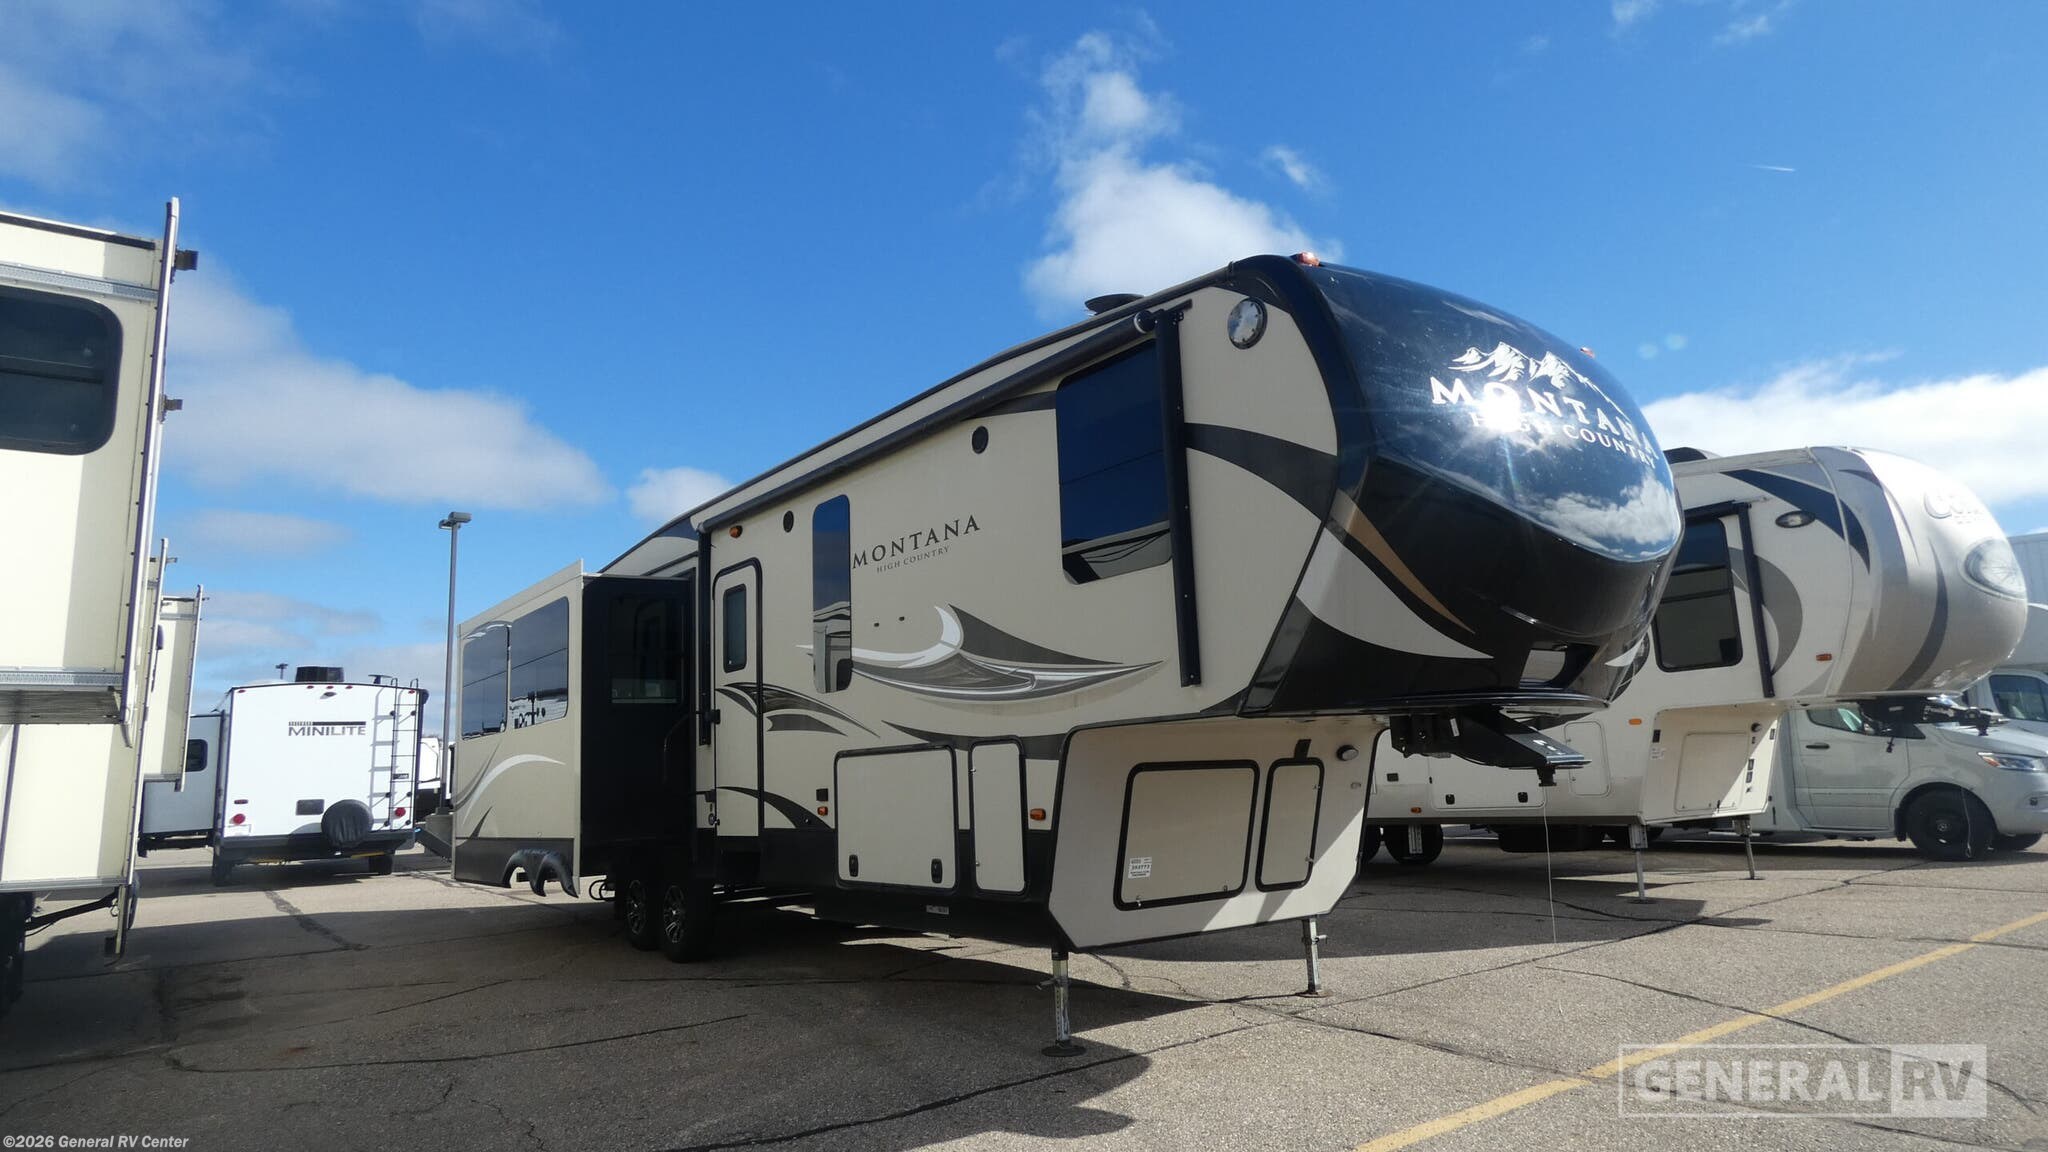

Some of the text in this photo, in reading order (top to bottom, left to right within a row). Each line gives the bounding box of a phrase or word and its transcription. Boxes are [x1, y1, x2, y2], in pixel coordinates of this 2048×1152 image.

[1429, 376, 1660, 461] MONTANA
[1562, 424, 1656, 469] COUNTRY
[852, 514, 981, 569] MONTANA
[876, 545, 950, 574] HIGH COUNTRY
[288, 726, 366, 736] MINILITE
